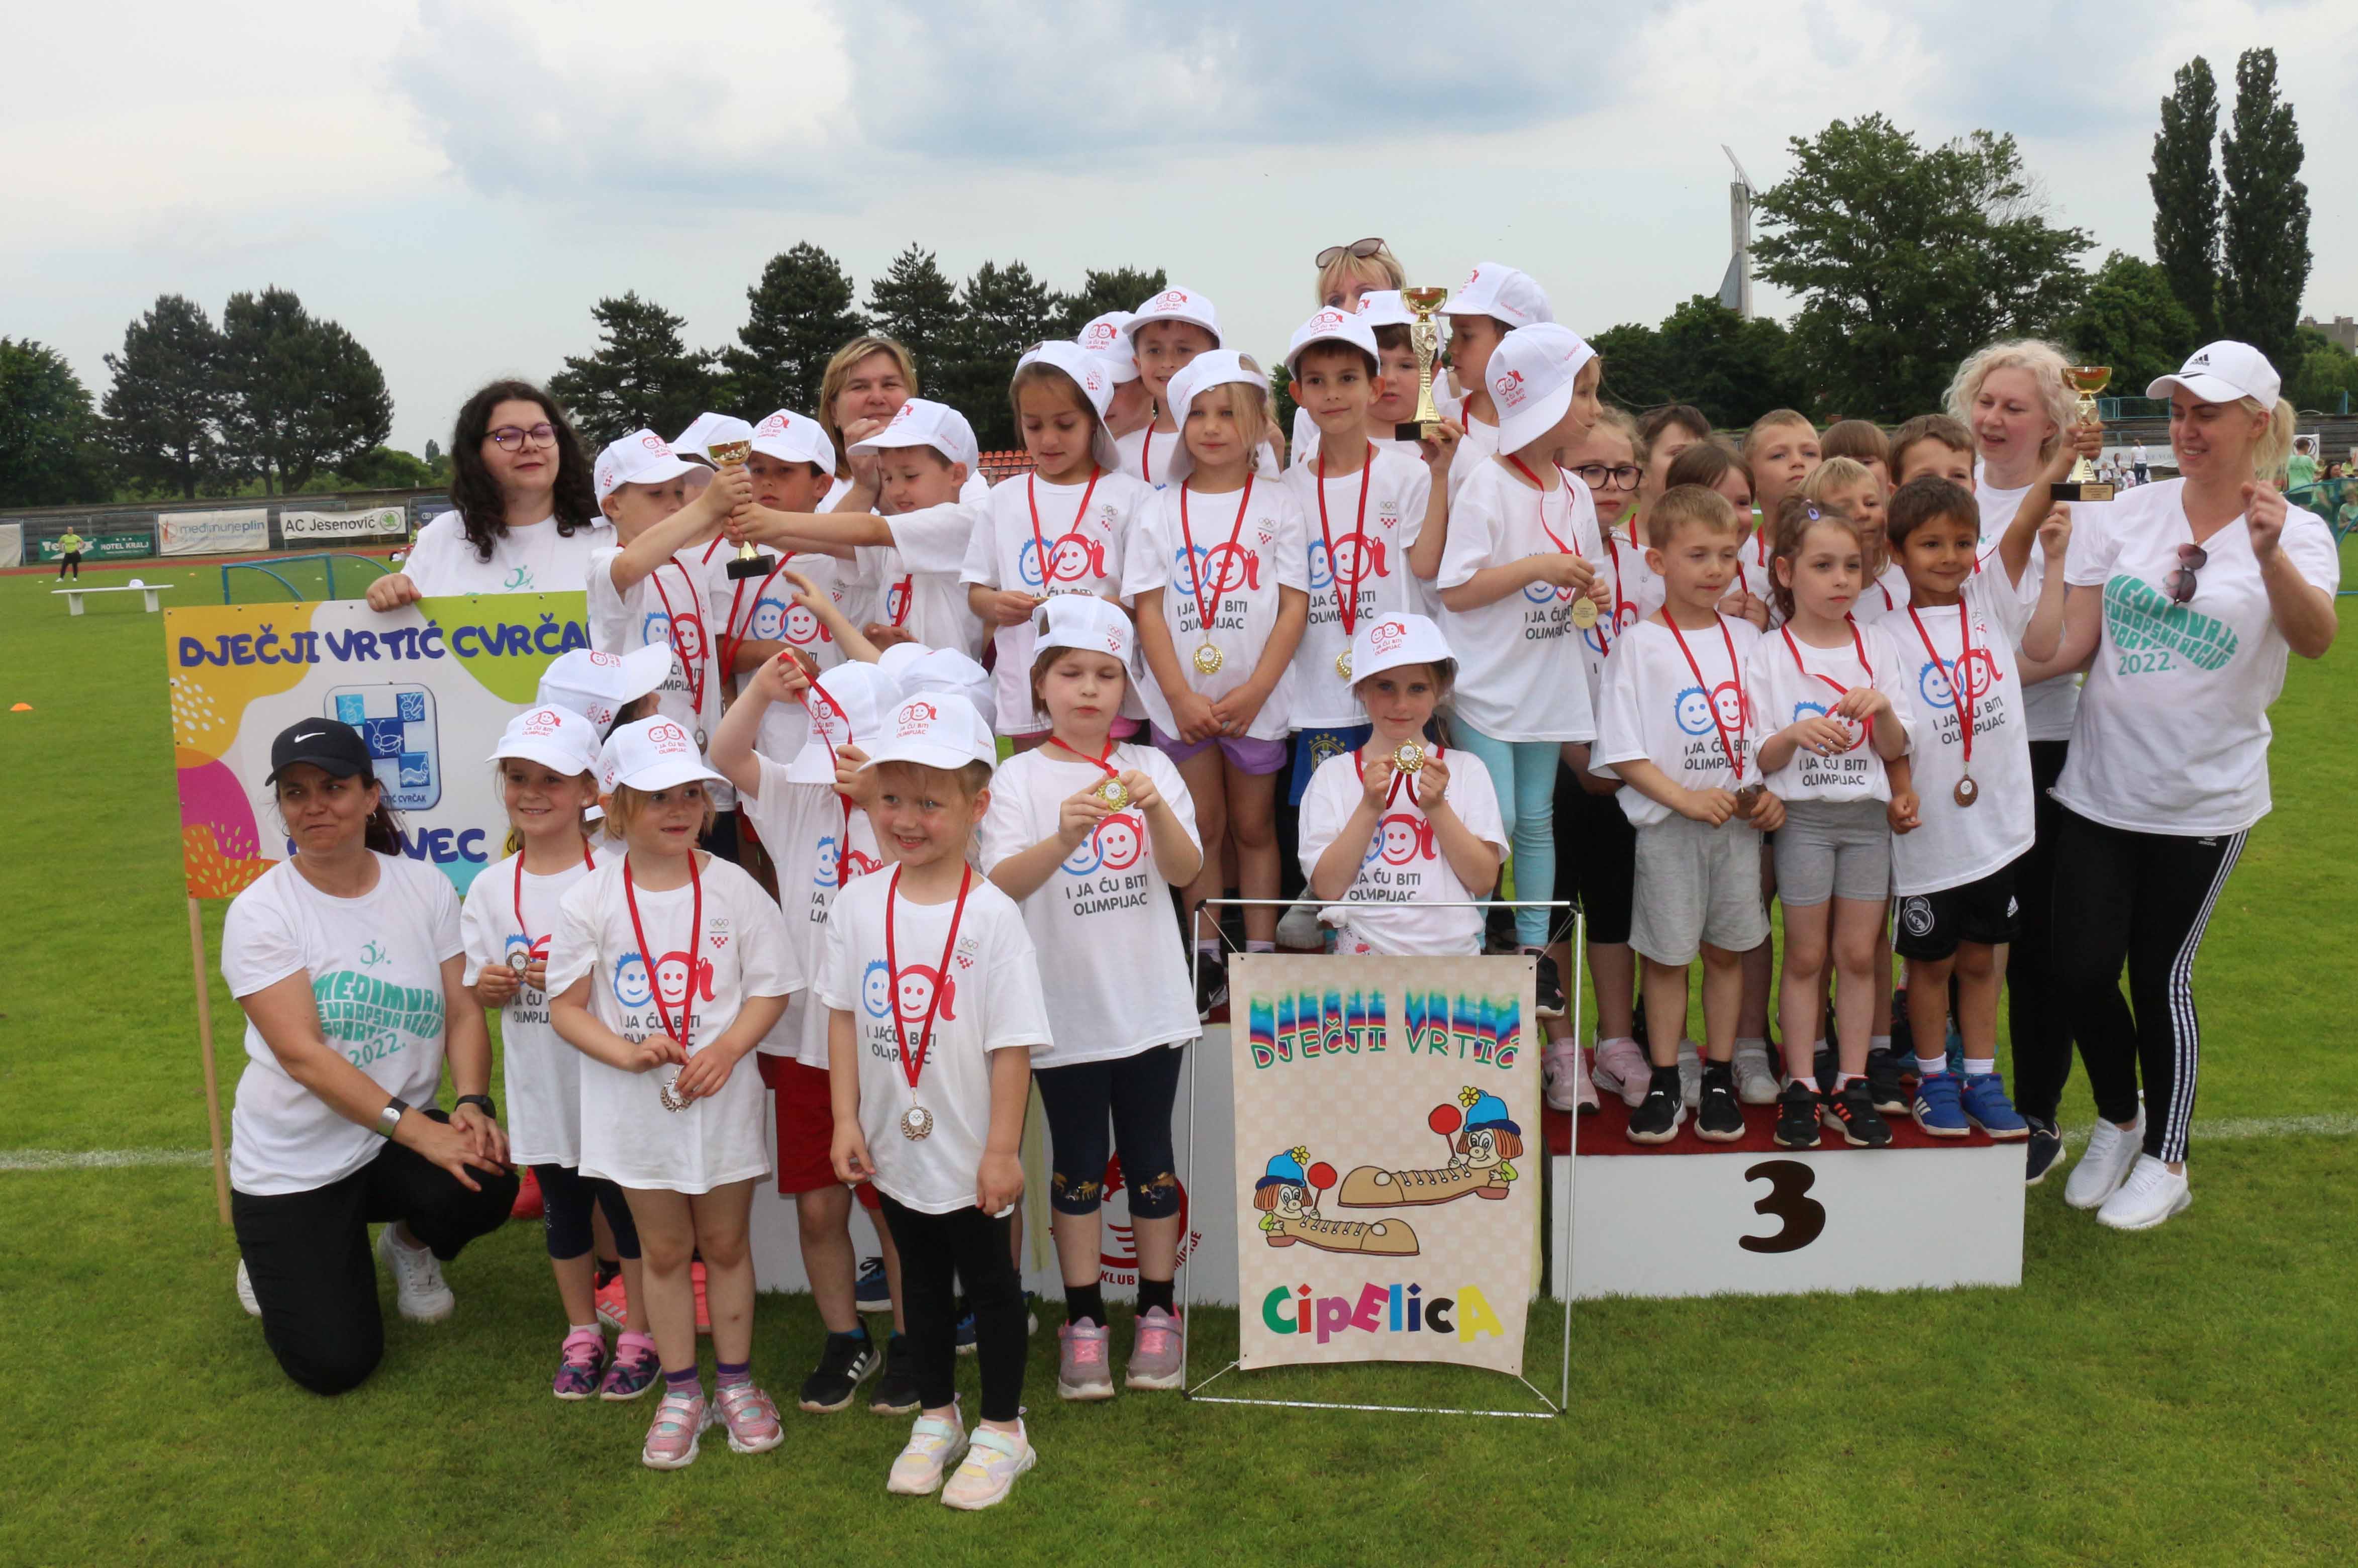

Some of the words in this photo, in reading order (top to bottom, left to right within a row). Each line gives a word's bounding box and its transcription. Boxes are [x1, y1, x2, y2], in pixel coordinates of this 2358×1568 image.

[285, 520, 305, 532] AC
[309, 516, 375, 531] Jesenović
[1182, 601, 1196, 616] JA
[1225, 601, 1247, 613] BITI
[1532, 612, 1546, 623] JA
[179, 624, 321, 667] DJEČJI
[325, 619, 446, 661] VRTIĆ
[452, 613, 592, 658] CVRČA
[2117, 651, 2177, 675] 2022.
[1933, 720, 1938, 731] I
[1987, 695, 2004, 713] BITI
[1690, 742, 1705, 754] JA
[1799, 760, 1802, 771] I
[1805, 758, 1818, 770] JA
[1845, 759, 1867, 771] BITI
[1802, 774, 1866, 787] OLIMPIJAC
[399, 793, 426, 803] CVRČAK
[1373, 867, 1391, 884] ĆU
[1397, 873, 1421, 886] BITI
[1066, 887, 1070, 899] I
[1076, 883, 1094, 898] JA
[1099, 876, 1119, 893] ĆU
[1125, 874, 1147, 890] BITI
[1073, 893, 1147, 916] OLIMPIJAC
[527, 990, 542, 1006] ĆU
[625, 1014, 640, 1029] JA
[866, 1024, 869, 1038] I
[348, 1032, 406, 1069] 2022.
[1250, 1020, 1387, 1069] DJEČJI
[1406, 1026, 1520, 1070] VRTIĆ
[1738, 1159, 1826, 1254] 3
[1100, 1270, 1136, 1286] KLUB
